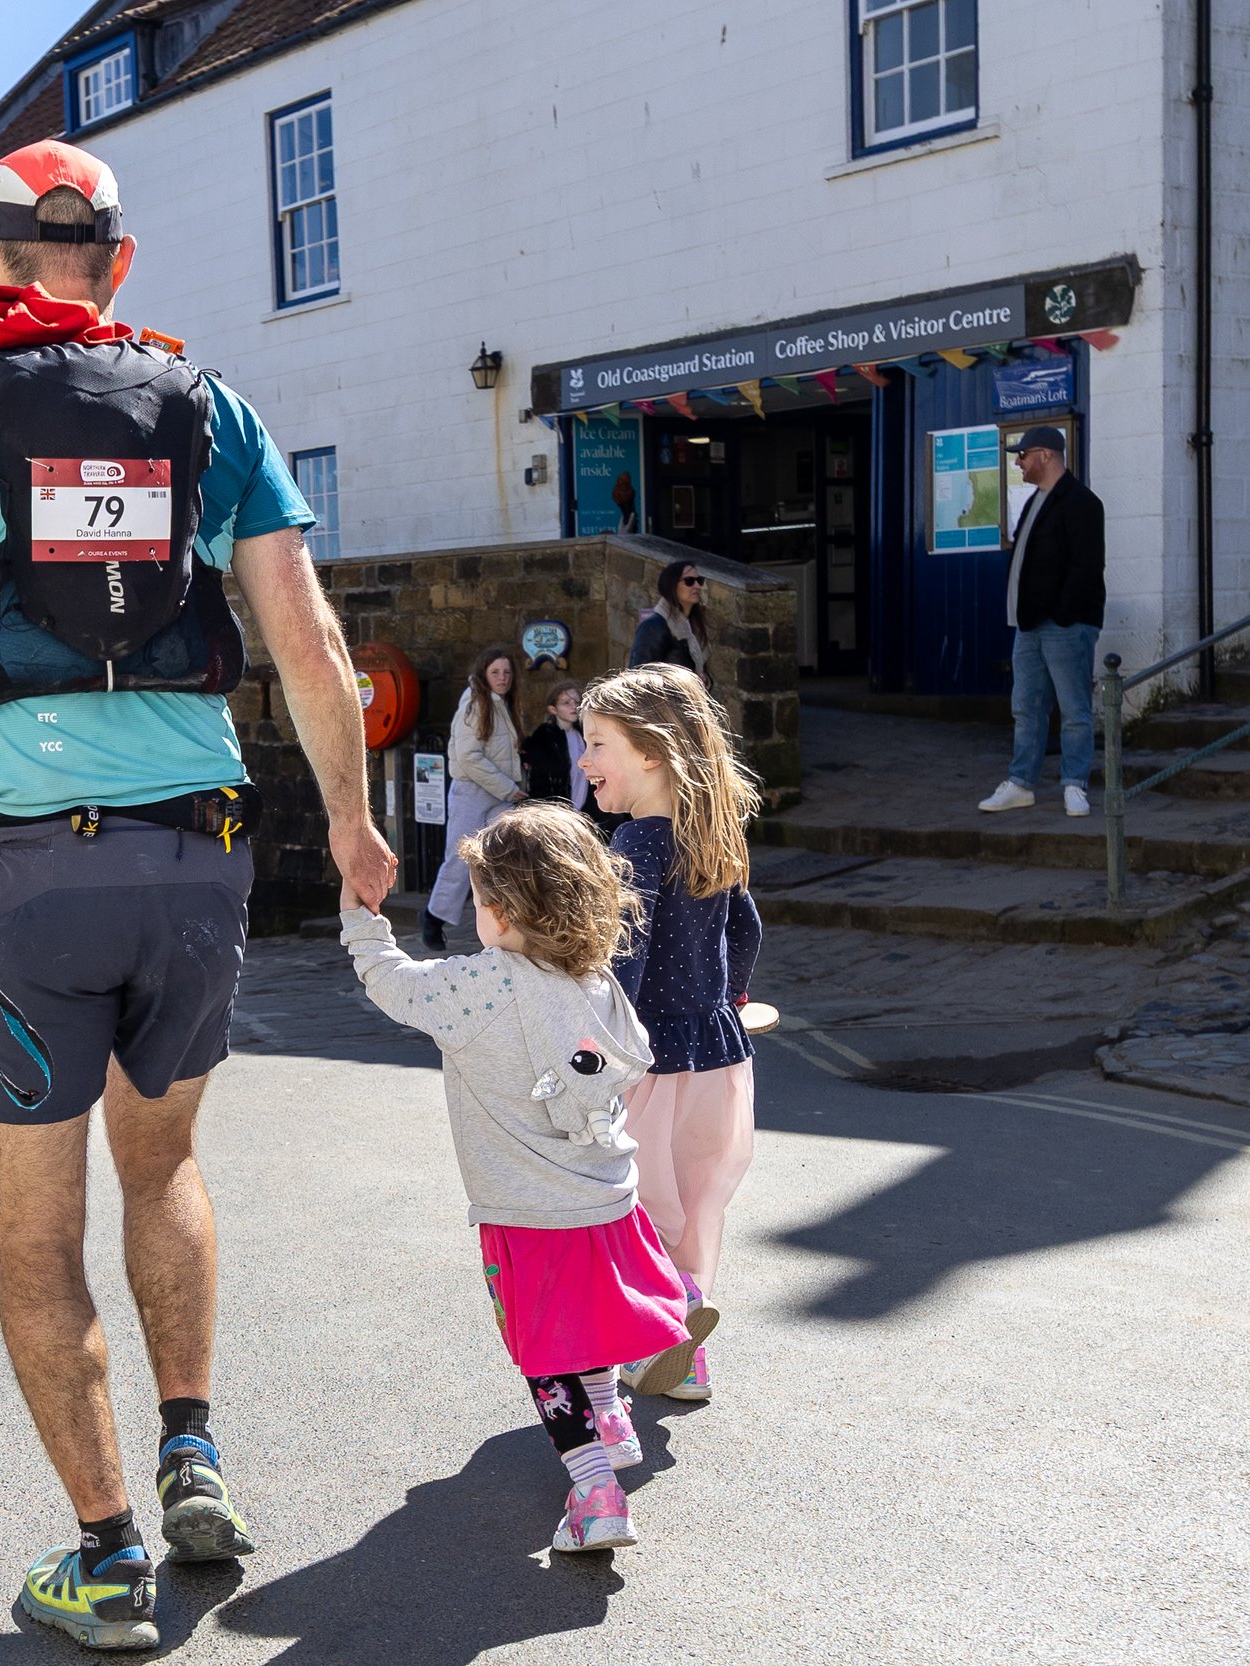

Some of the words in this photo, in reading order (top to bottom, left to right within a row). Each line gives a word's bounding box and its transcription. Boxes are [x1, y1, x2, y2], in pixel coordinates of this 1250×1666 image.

[775, 335, 825, 360] Coffee
[828, 328, 869, 351] Shop
[872, 323, 886, 343] &
[889, 315, 946, 340] Visitor
[949, 306, 1011, 331] Centre
[597, 367, 621, 389] Old
[623, 354, 700, 385] Coastguard
[702, 348, 755, 372] Station
[1000, 391, 1047, 409] Boatman's
[1048, 388, 1068, 402] Loft
[579, 426, 596, 440] Ice
[599, 426, 636, 440] Cream
[580, 445, 626, 459] available
[580, 463, 612, 477] inside
[84, 495, 125, 528] 79
[76, 529, 101, 538] David
[104, 529, 132, 538] Hanna
[106, 561, 125, 614] MON
[37, 712, 58, 724] ETC
[39, 741, 63, 753] YCC
[82, 805, 99, 838] aked
